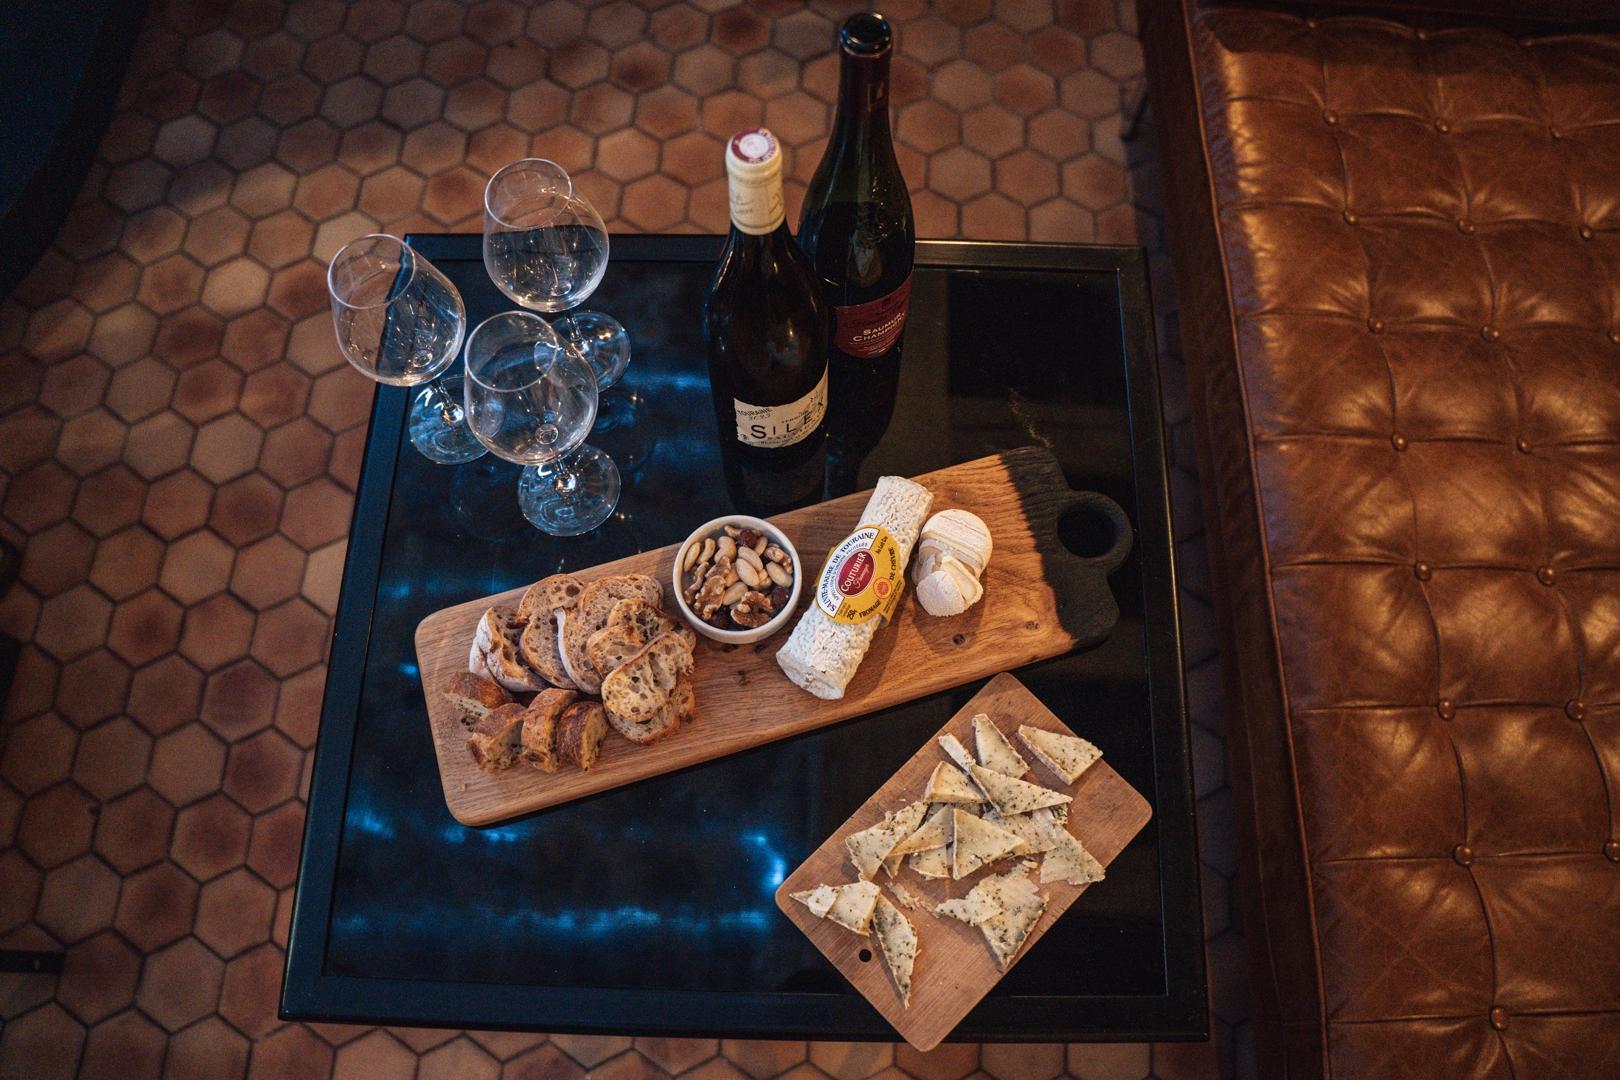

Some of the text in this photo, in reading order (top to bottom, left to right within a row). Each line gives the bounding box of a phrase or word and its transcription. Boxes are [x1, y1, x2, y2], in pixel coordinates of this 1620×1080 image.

[832, 554, 841, 564] DE
[840, 532, 875, 553] TOURAINE
[841, 552, 867, 592] COUTURIER
[889, 573, 896, 581] DE
[859, 600, 881, 618] FROMAGE
